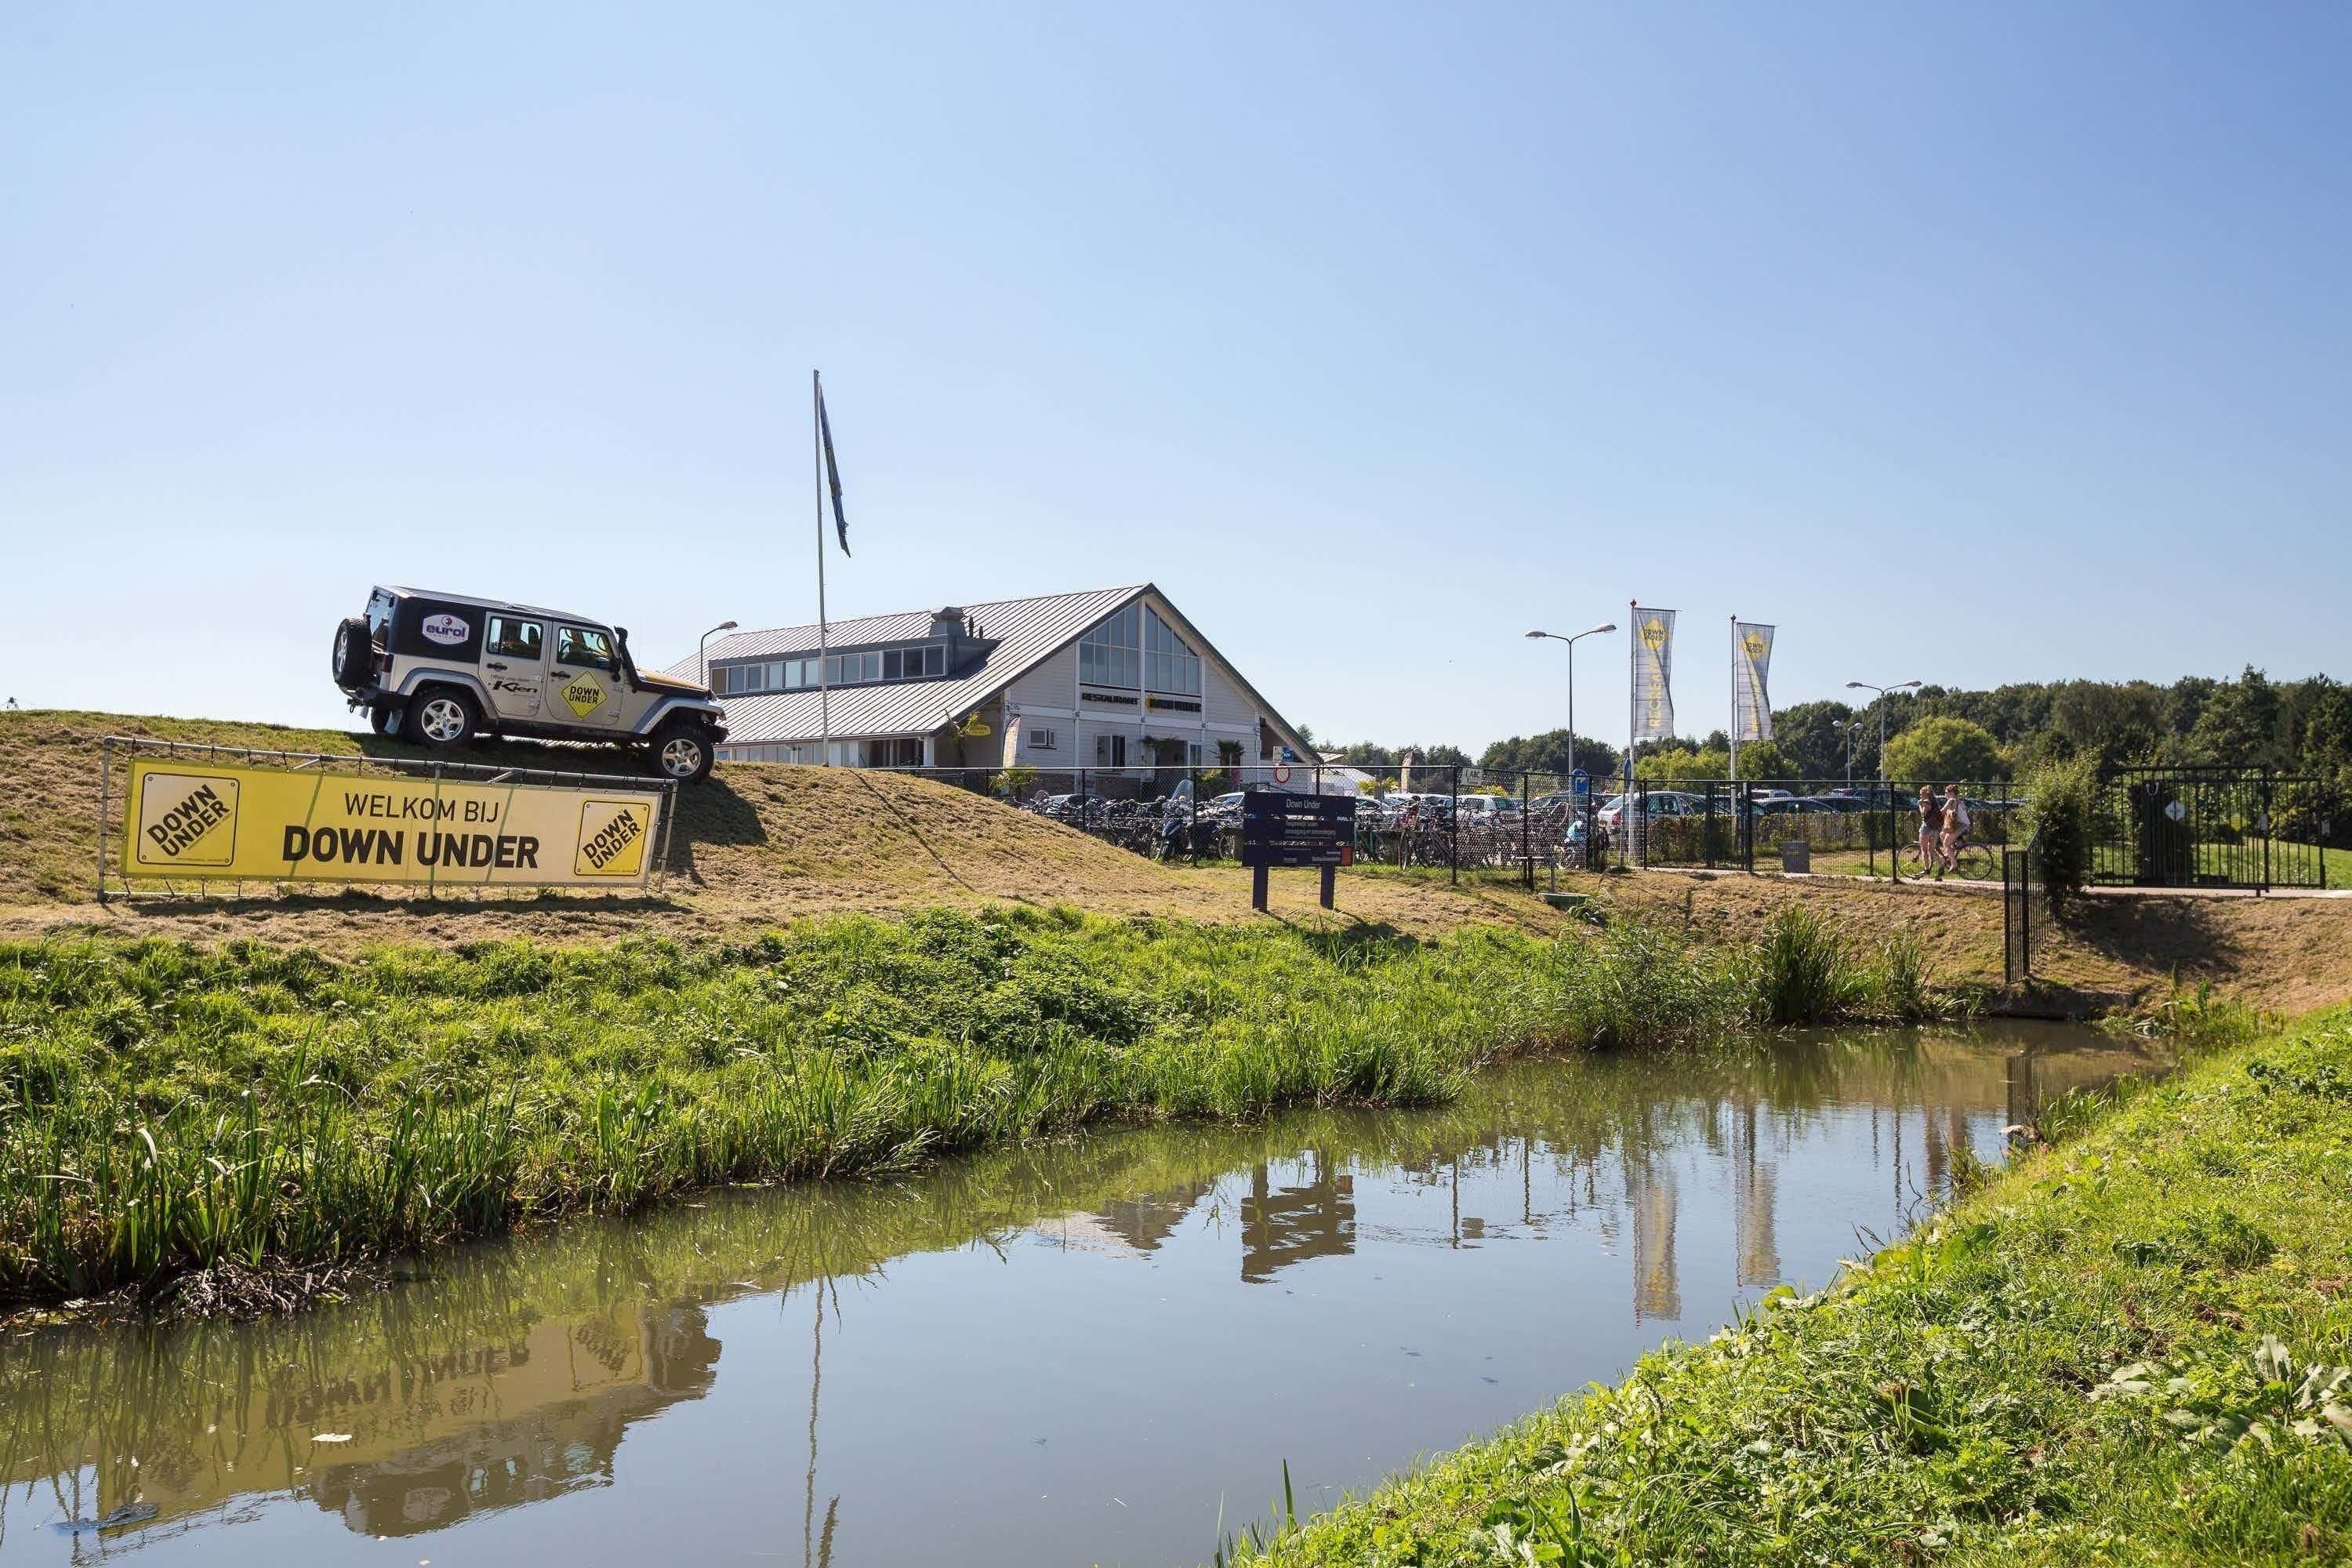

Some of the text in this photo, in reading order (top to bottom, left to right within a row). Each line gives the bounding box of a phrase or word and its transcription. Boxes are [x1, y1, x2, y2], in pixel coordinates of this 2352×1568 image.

[426, 624, 466, 638] eurol
[493, 681, 538, 694] Kien
[568, 694, 599, 705] UNDER
[570, 686, 600, 697] DOWN
[147, 783, 217, 845] DOWN
[344, 793, 499, 823] WELKOM BIJ
[1286, 799, 1321, 809] Down Under
[161, 800, 230, 857] UNDER
[583, 809, 633, 860] DOWN
[282, 825, 540, 869] DOWN UNDER
[591, 822, 641, 869] UNDER
